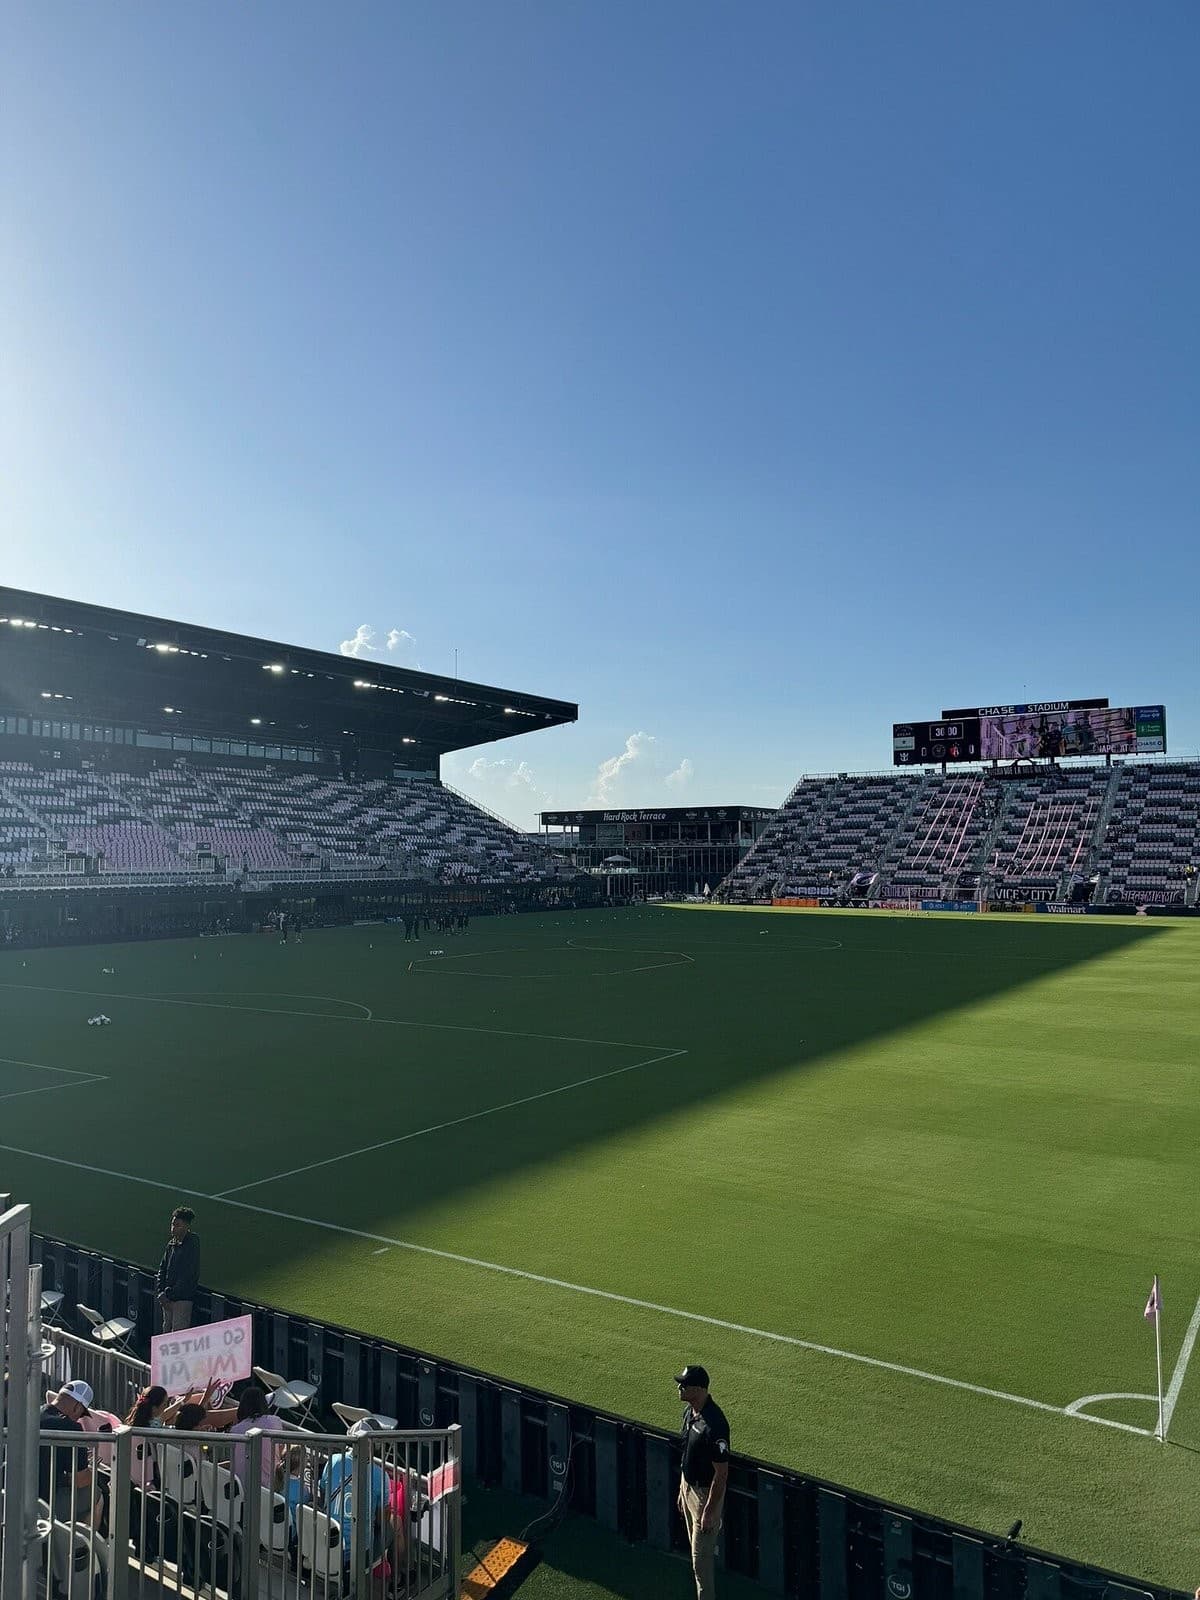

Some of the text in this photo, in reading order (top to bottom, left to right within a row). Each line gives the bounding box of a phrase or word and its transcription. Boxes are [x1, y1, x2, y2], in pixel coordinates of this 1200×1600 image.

[978, 702, 1069, 716] CHASE STADIUM
[603, 810, 666, 823] Hard Rock Terrace
[994, 888, 1055, 901] VICE CITY
[1047, 904, 1087, 914] Walmart
